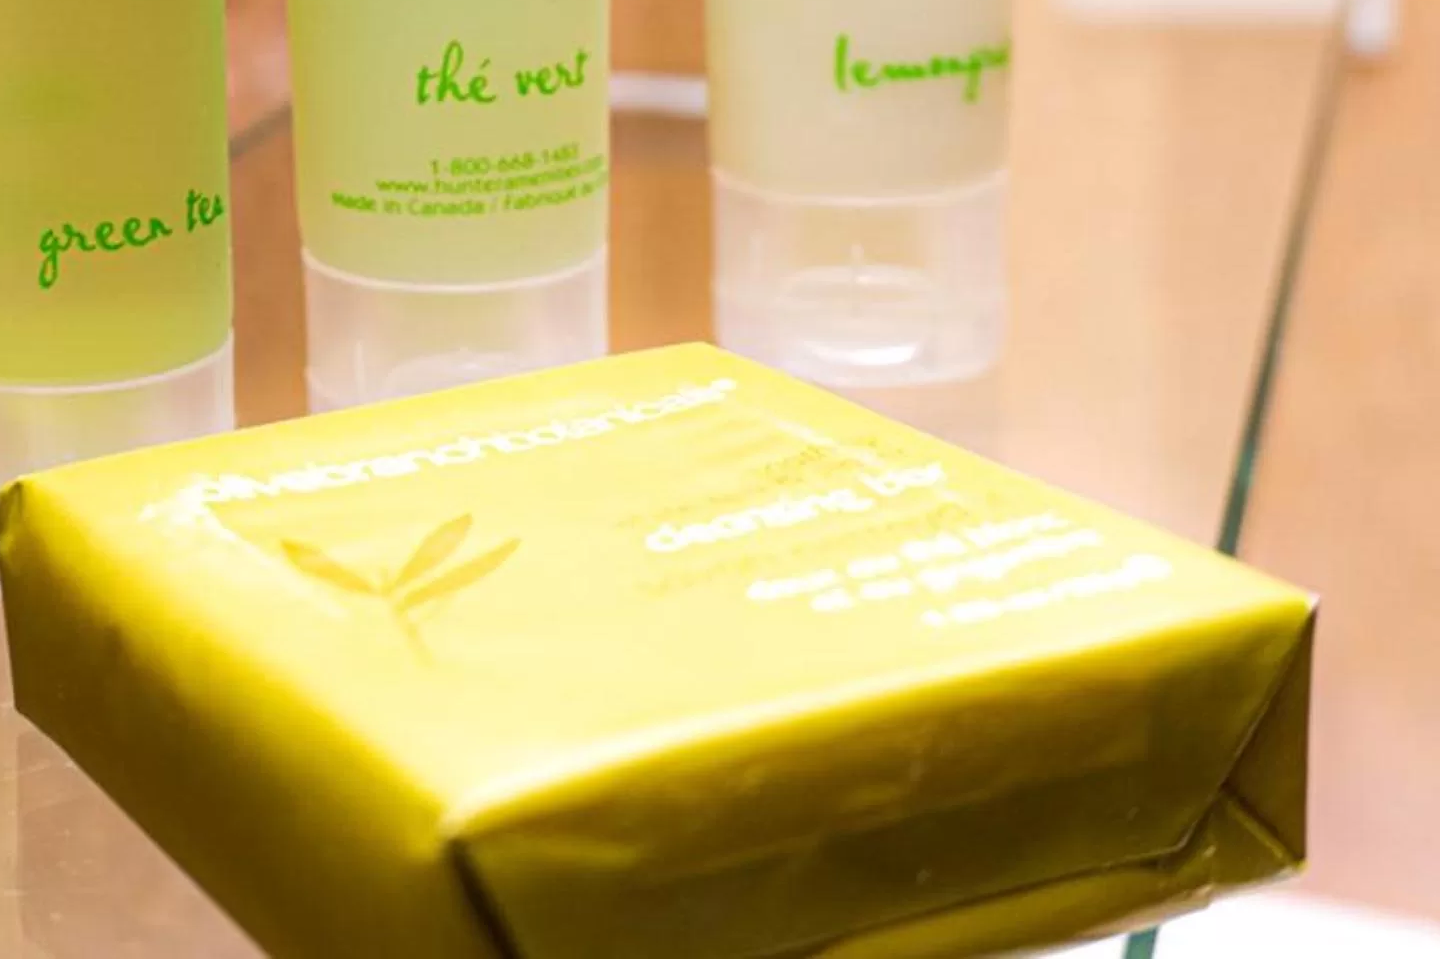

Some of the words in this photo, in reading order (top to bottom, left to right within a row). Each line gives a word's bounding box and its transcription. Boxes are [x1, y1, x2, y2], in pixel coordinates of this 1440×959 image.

[417, 39, 497, 105] thé
[514, 47, 588, 96] vert
[332, 191, 377, 213] Made
[383, 198, 402, 215] in
[409, 197, 486, 218] Canada
[38, 216, 173, 290] green
